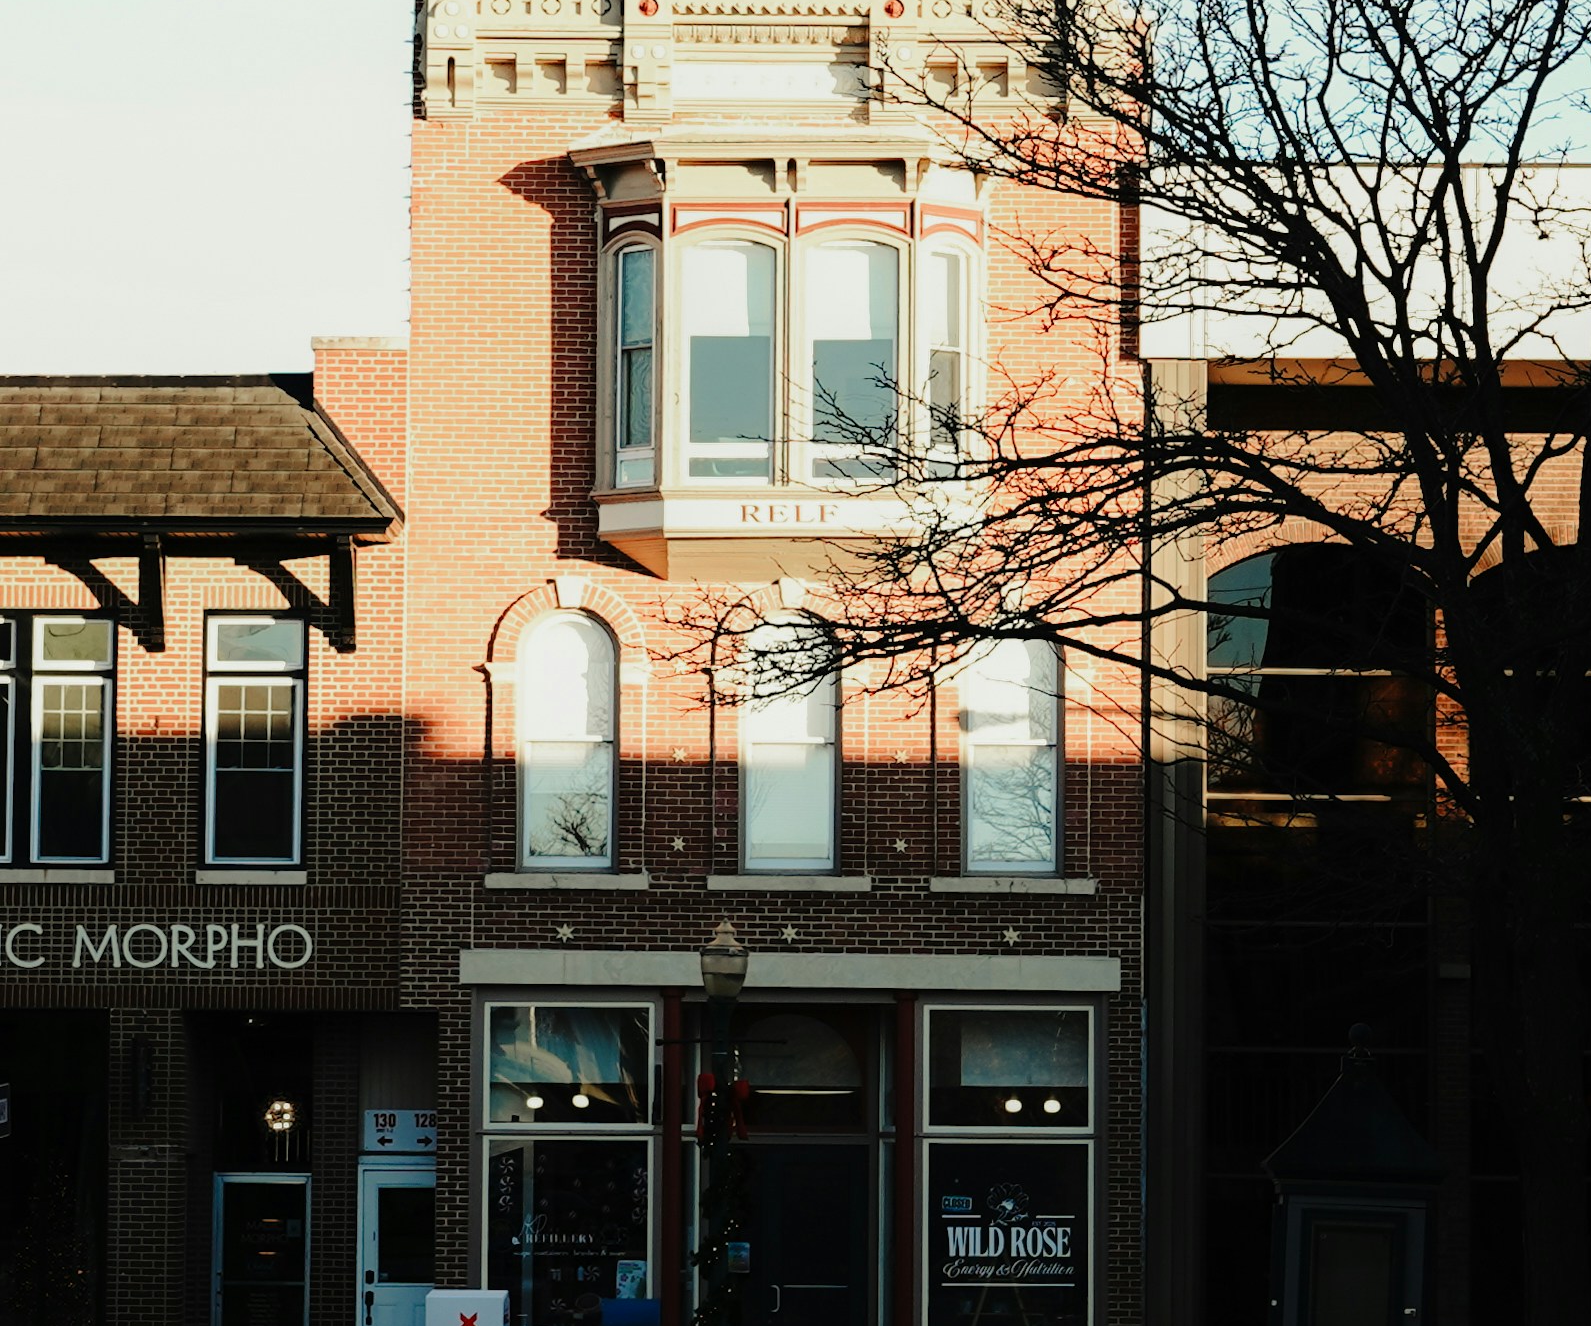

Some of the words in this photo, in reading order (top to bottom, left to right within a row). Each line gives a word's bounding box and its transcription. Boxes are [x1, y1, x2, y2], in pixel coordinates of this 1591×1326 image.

[740, 504, 839, 523] RELF
[0, 924, 45, 969] C
[72, 924, 313, 969] MORPHO
[374, 1114, 396, 1127] 130
[414, 1114, 437, 1127] 128
[525, 1233, 595, 1244] REFILLERY
[947, 1226, 1005, 1257] WILD
[1010, 1226, 1071, 1257] ROSE
[942, 1258, 996, 1279] Energy
[995, 1264, 1011, 1275] &
[1010, 1259, 1076, 1279] Nutrition
